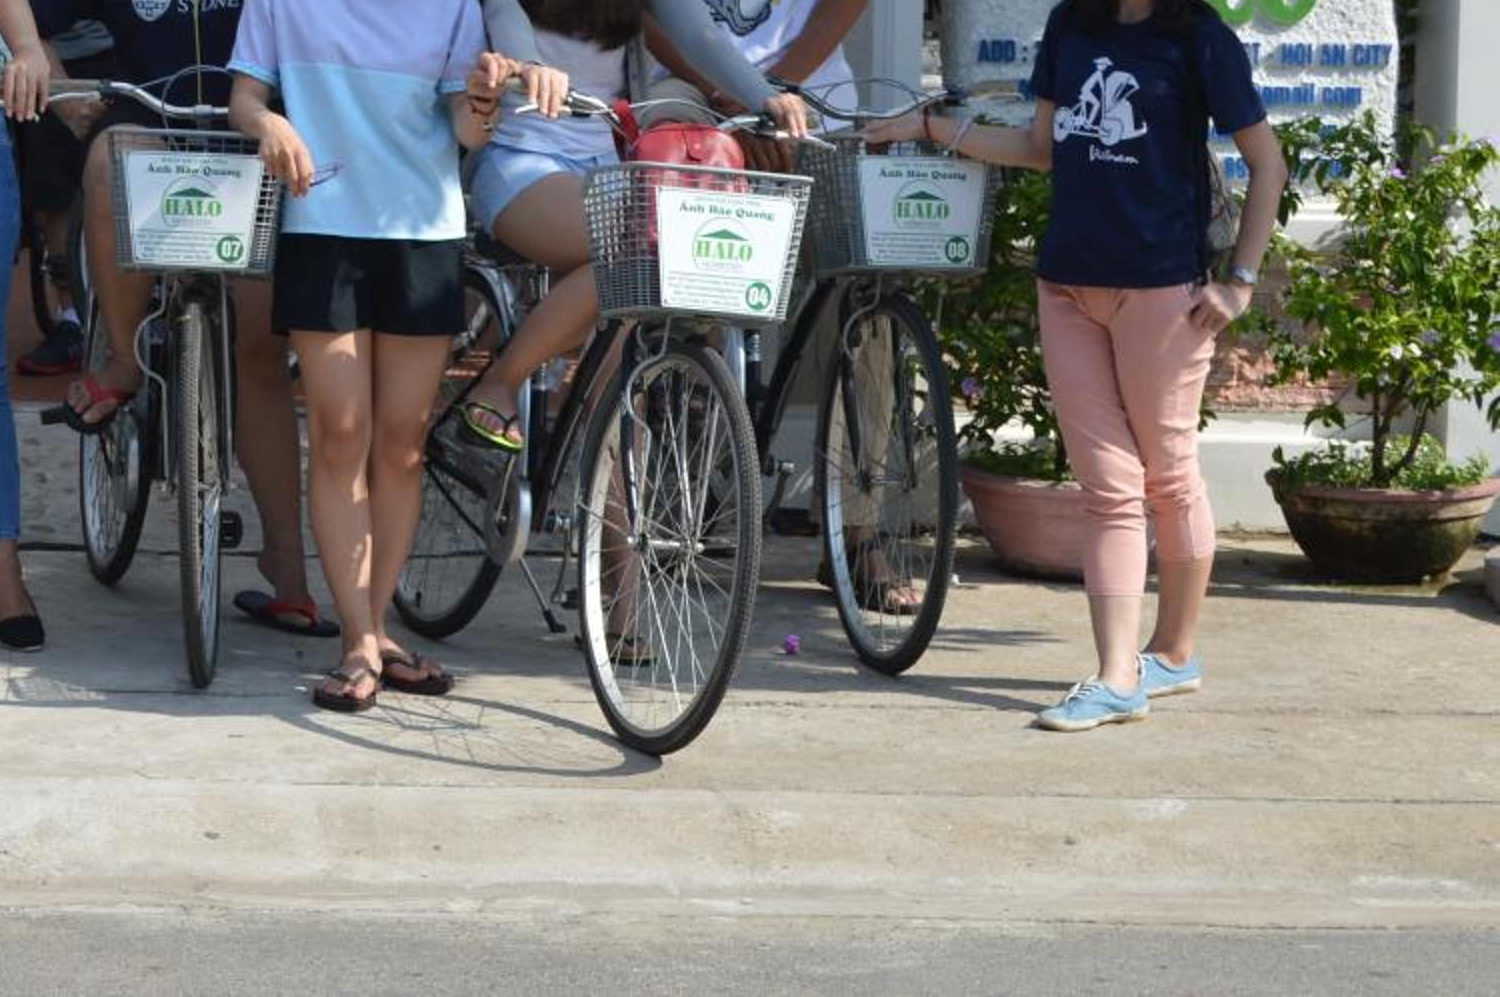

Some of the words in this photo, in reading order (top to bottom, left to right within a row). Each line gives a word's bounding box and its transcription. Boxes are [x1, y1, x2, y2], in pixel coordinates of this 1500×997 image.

[1353, 43, 1393, 67] CITY
[164, 197, 223, 218] HALO
[897, 201, 950, 220] HALO
[220, 240, 242, 259] 07
[695, 239, 754, 264] HALO
[948, 241, 968, 260] 08
